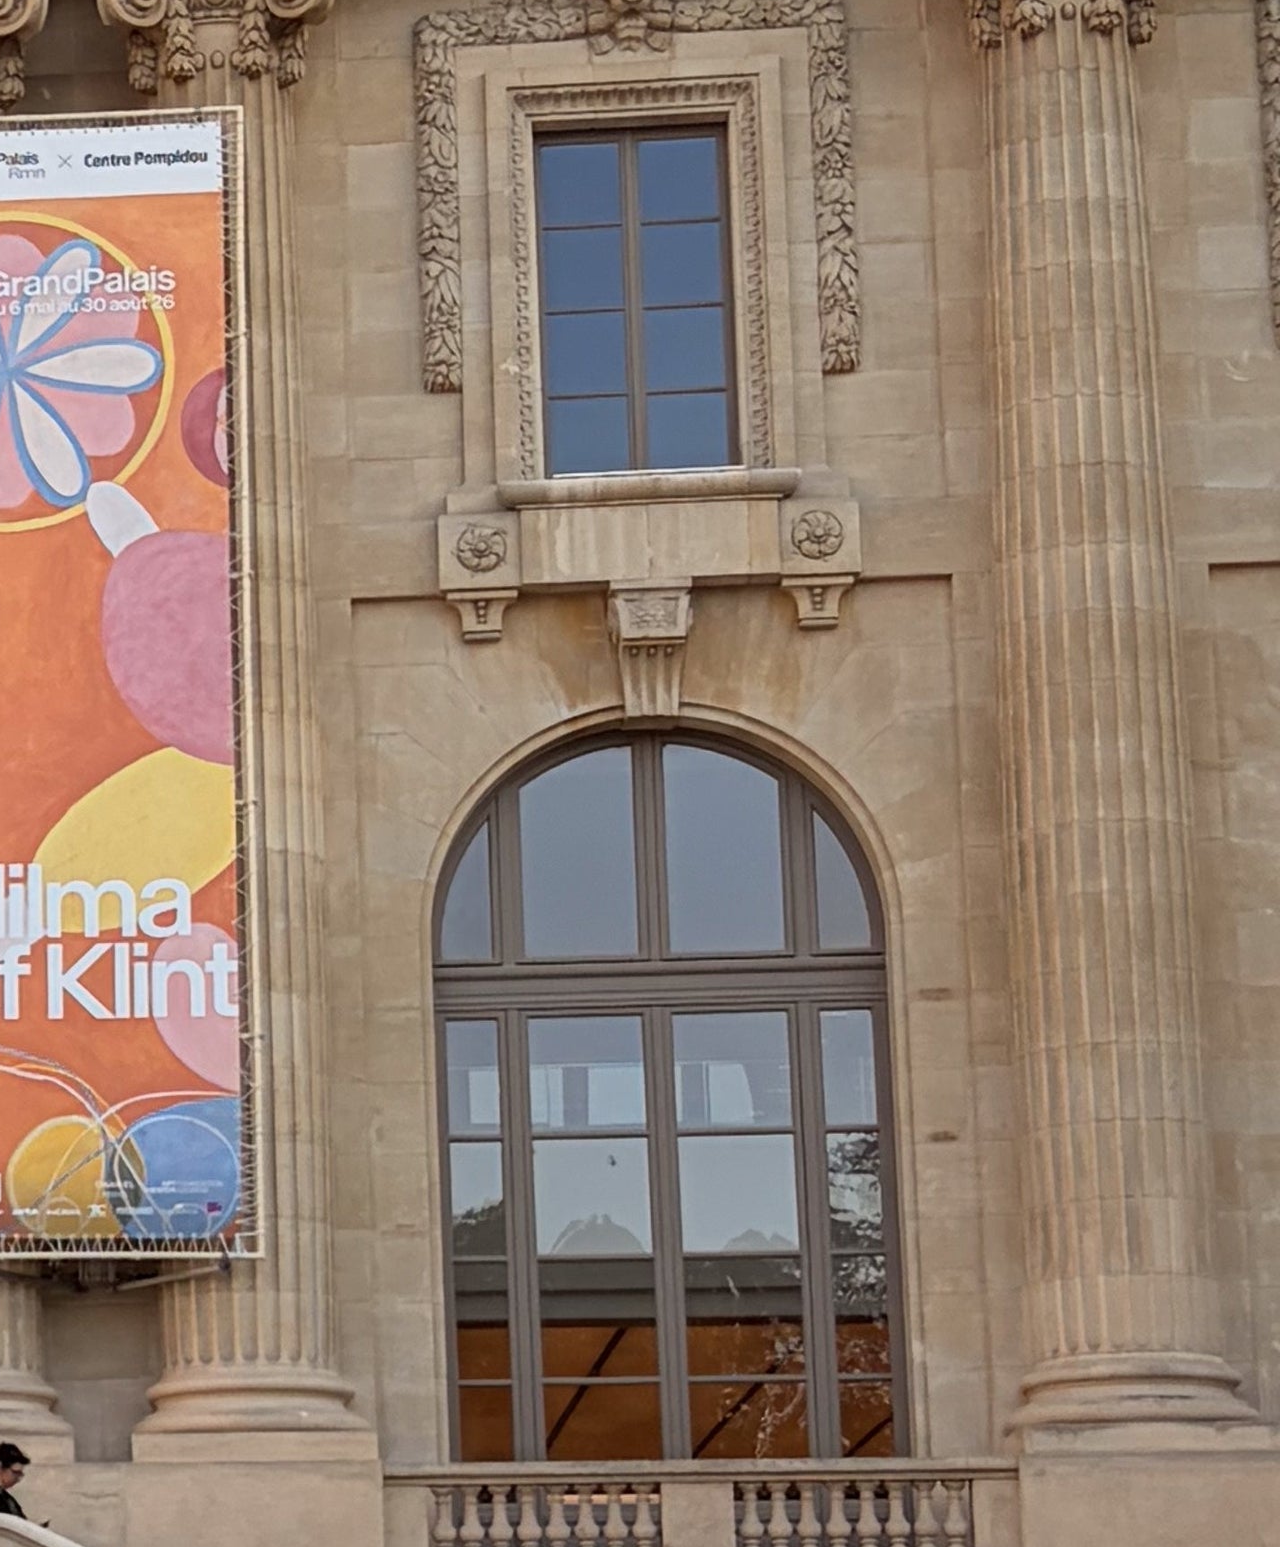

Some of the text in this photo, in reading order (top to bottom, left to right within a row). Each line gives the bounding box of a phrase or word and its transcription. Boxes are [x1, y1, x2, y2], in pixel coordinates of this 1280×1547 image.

[84, 154, 131, 168] Centre
[134, 150, 208, 167] Pompidou
[8, 168, 46, 180] Rmn
[8, 301, 21, 315] 6
[24, 299, 56, 314] mai
[58, 301, 78, 313] au
[80, 298, 106, 313] 30
[151, 294, 176, 310] 26
[47, 942, 239, 1020] Klint
